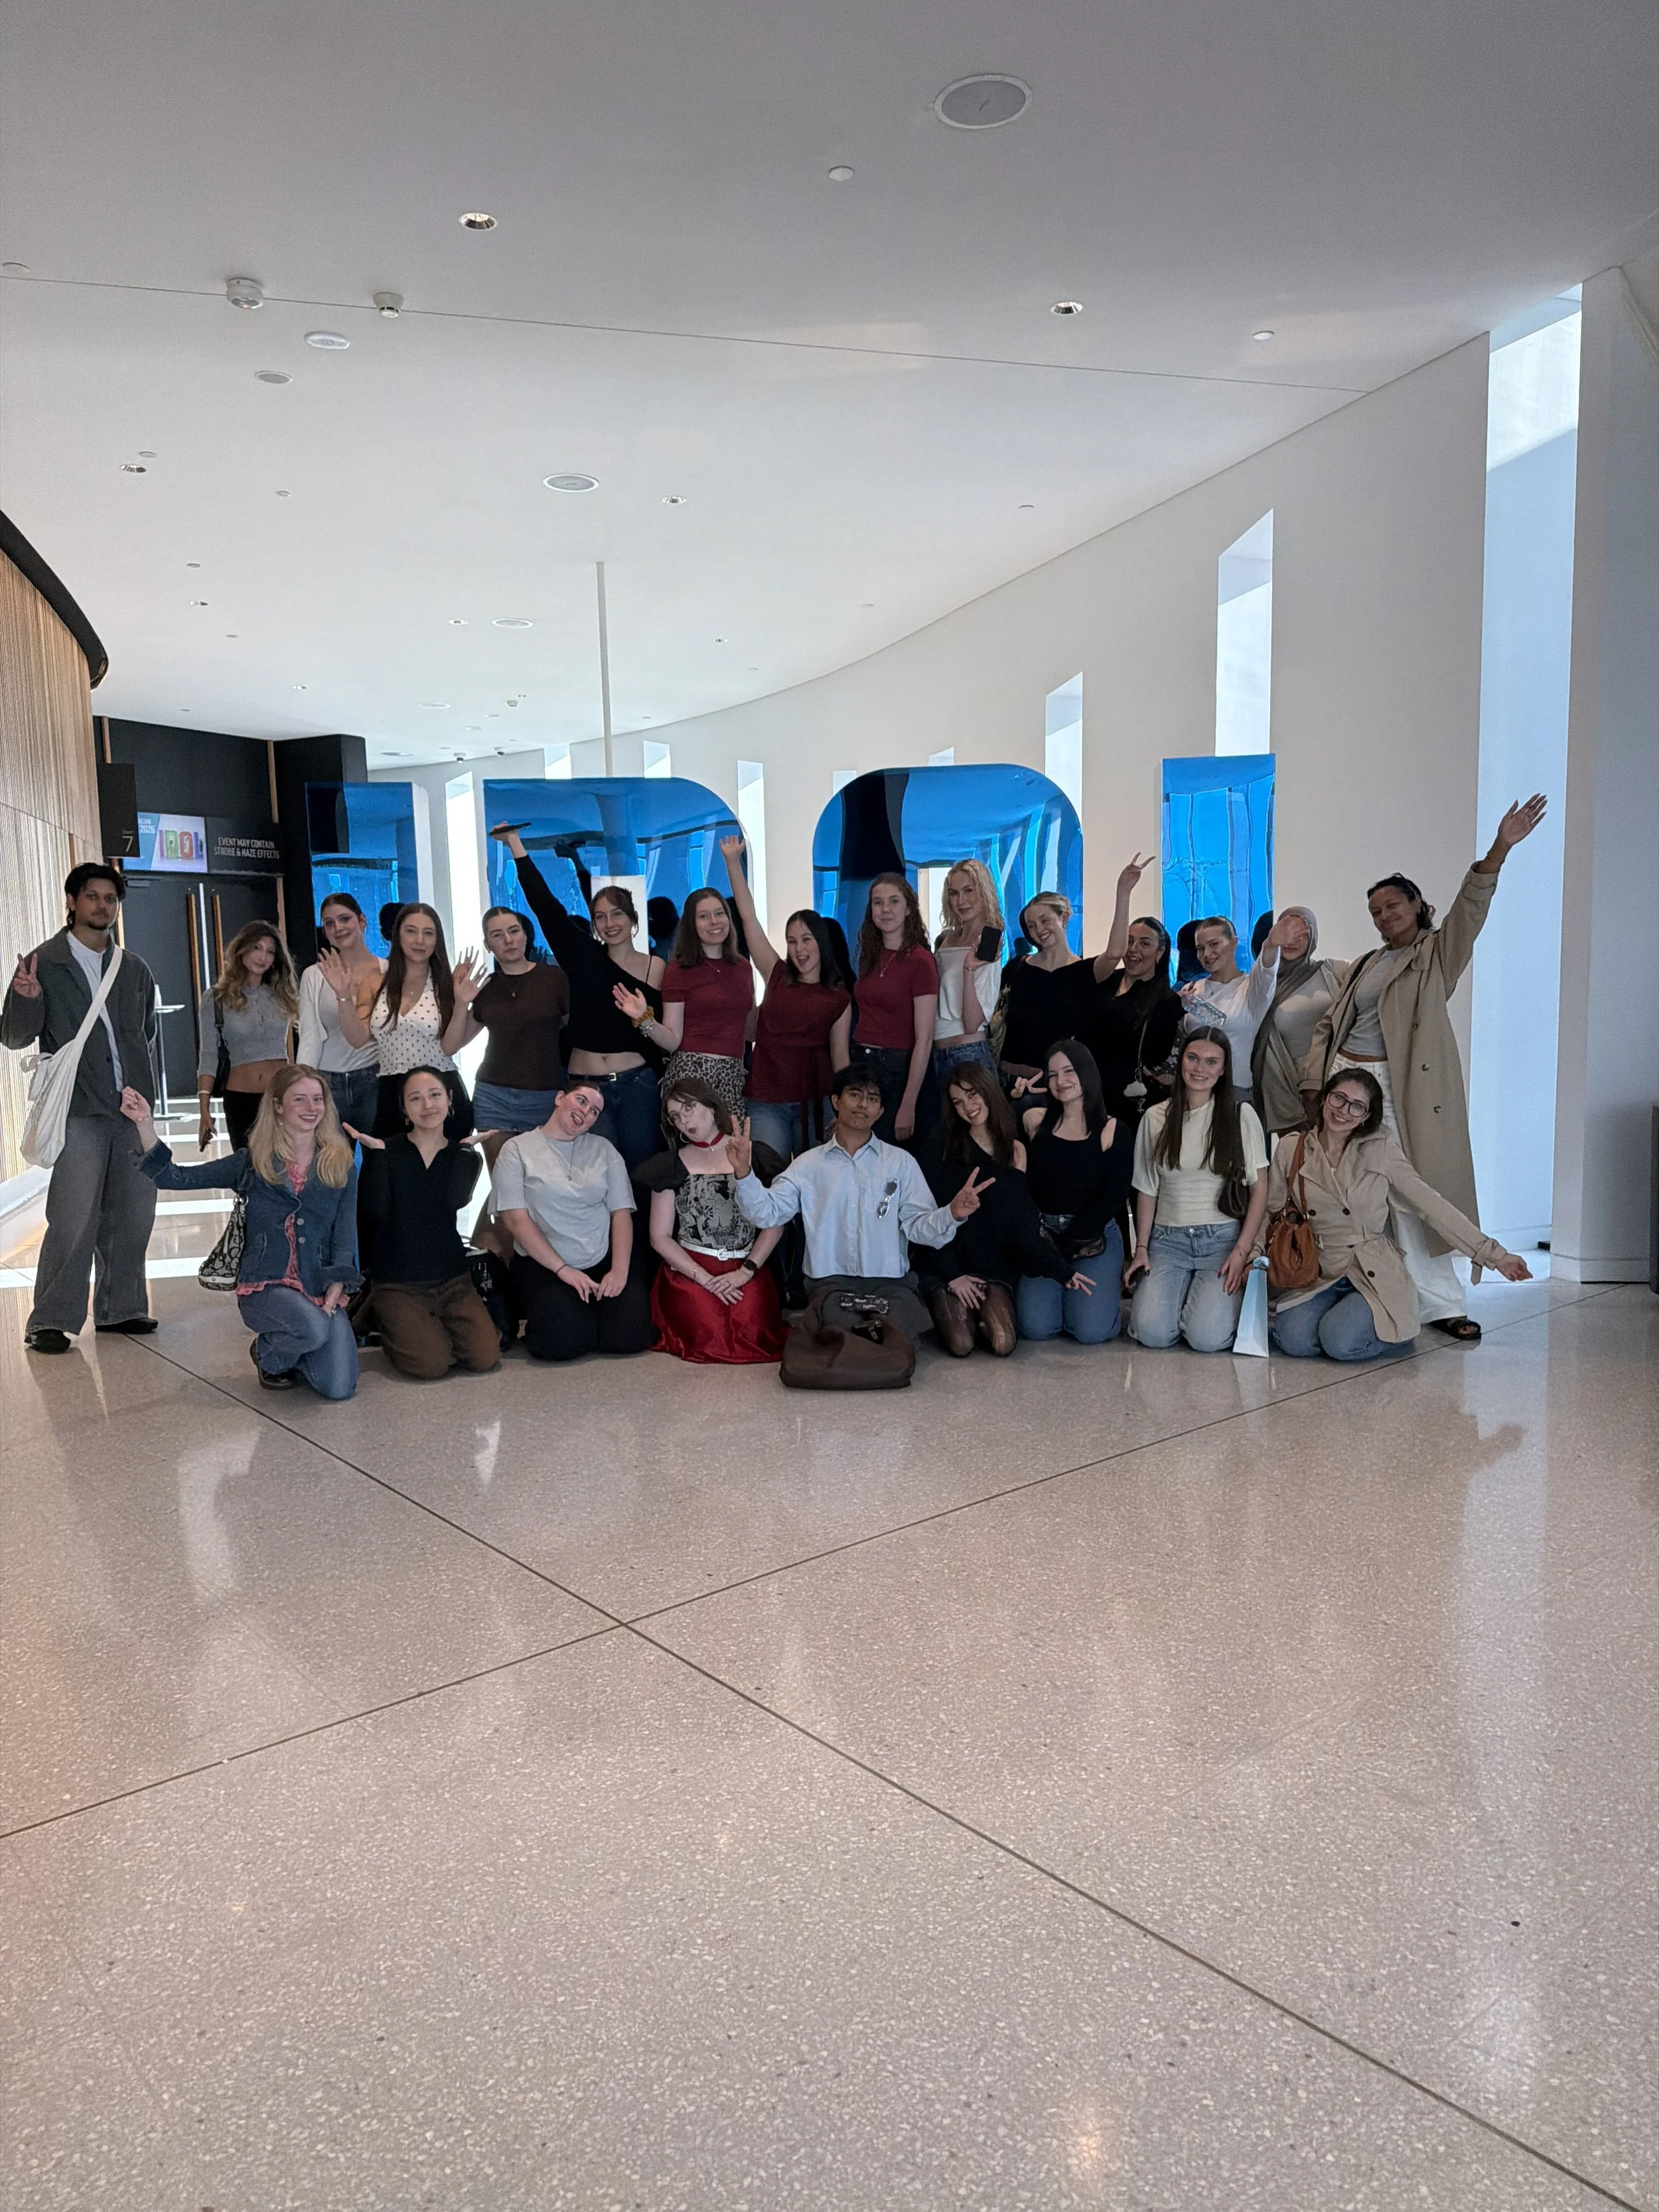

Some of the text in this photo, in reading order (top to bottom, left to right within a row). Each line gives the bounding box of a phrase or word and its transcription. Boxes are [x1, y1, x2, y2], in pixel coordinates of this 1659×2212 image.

[121, 836, 133, 852] 7
[218, 837, 275, 849] EVENT MAY CONTAIN
[242, 848, 256, 857] HAZE
[257, 849, 279, 859] EFFECTS
